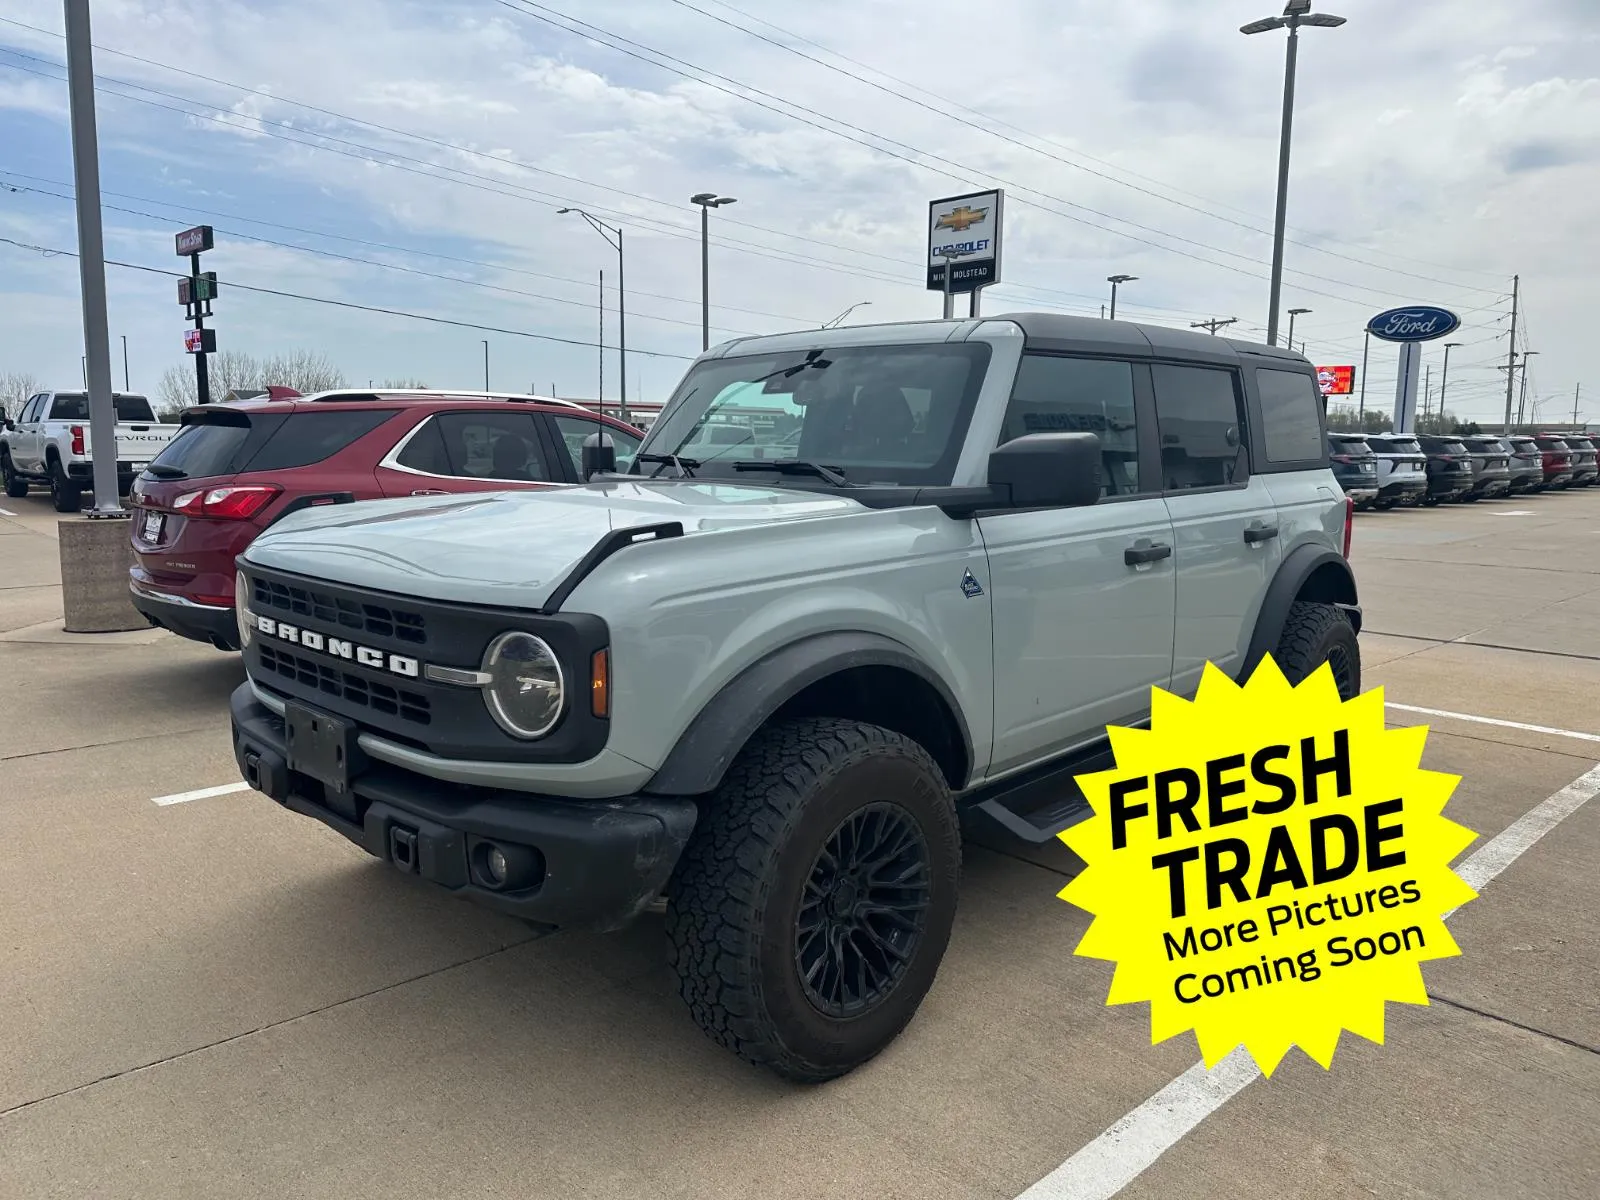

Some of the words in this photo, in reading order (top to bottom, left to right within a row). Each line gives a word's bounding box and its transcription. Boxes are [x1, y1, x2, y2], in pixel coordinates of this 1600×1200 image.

[933, 273, 945, 281] MIK
[954, 267, 987, 279] MOLSTEAD
[1384, 312, 1437, 335] Ford
[257, 616, 419, 677] BRONCO
